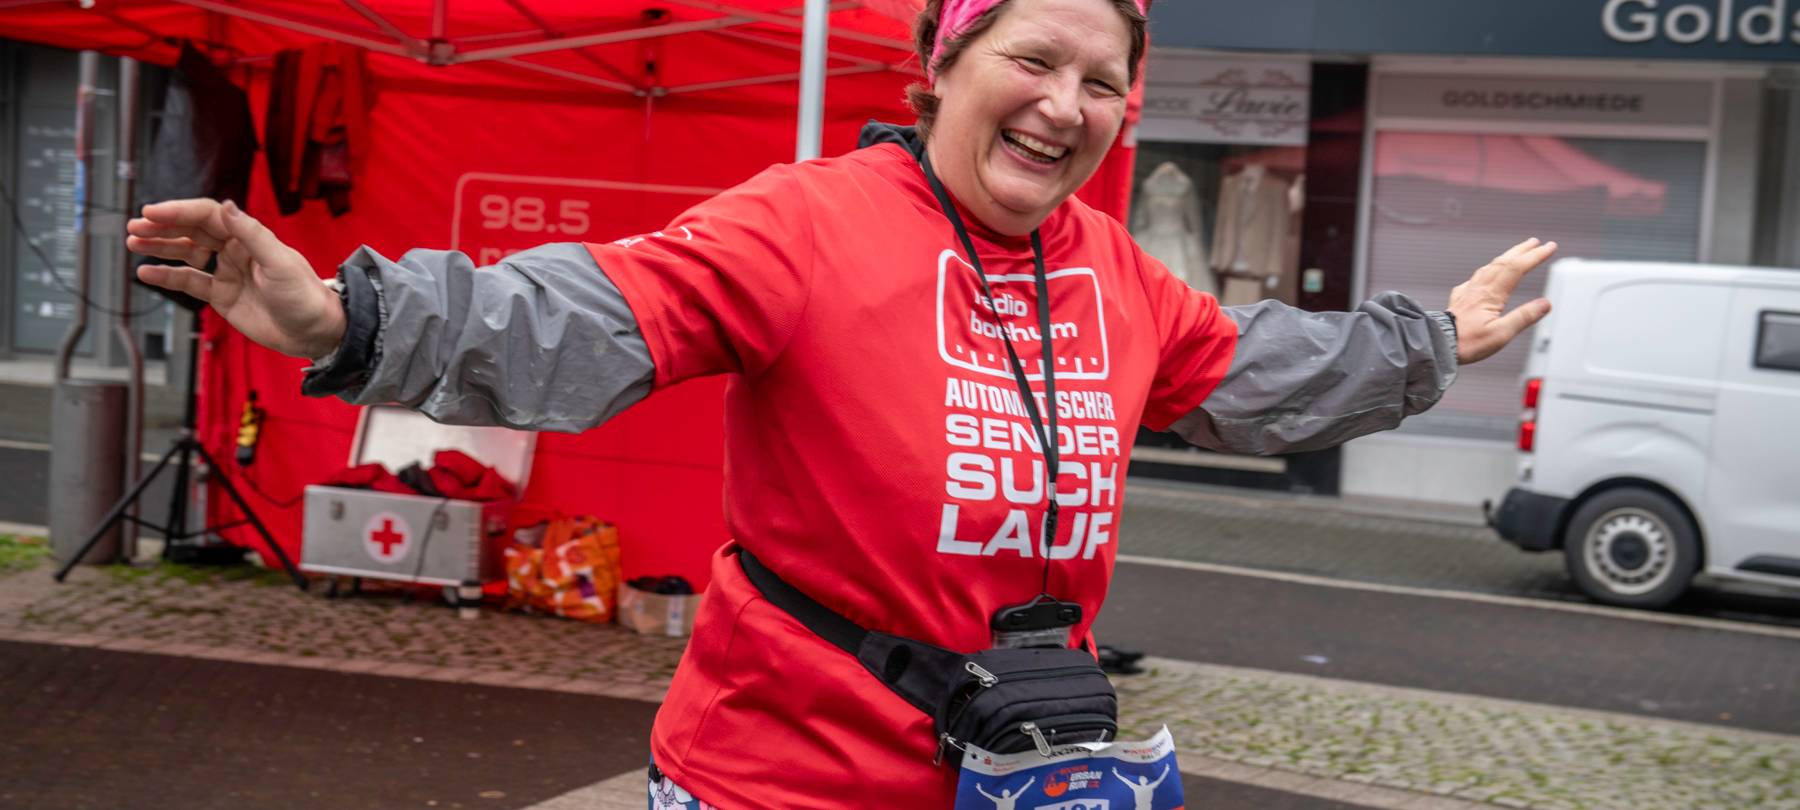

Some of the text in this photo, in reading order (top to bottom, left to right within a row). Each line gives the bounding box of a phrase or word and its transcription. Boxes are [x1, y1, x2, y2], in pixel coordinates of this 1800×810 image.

[1602, 0, 1800, 43] Gold
[1442, 90, 1643, 112] GOLDSCHMIEDE
[479, 194, 591, 235] 98.5
[945, 378, 1116, 420] AUTOMTSCHER
[945, 414, 1120, 456] SENDER
[945, 452, 1118, 506] SUCH
[936, 503, 1113, 560] LAUF
